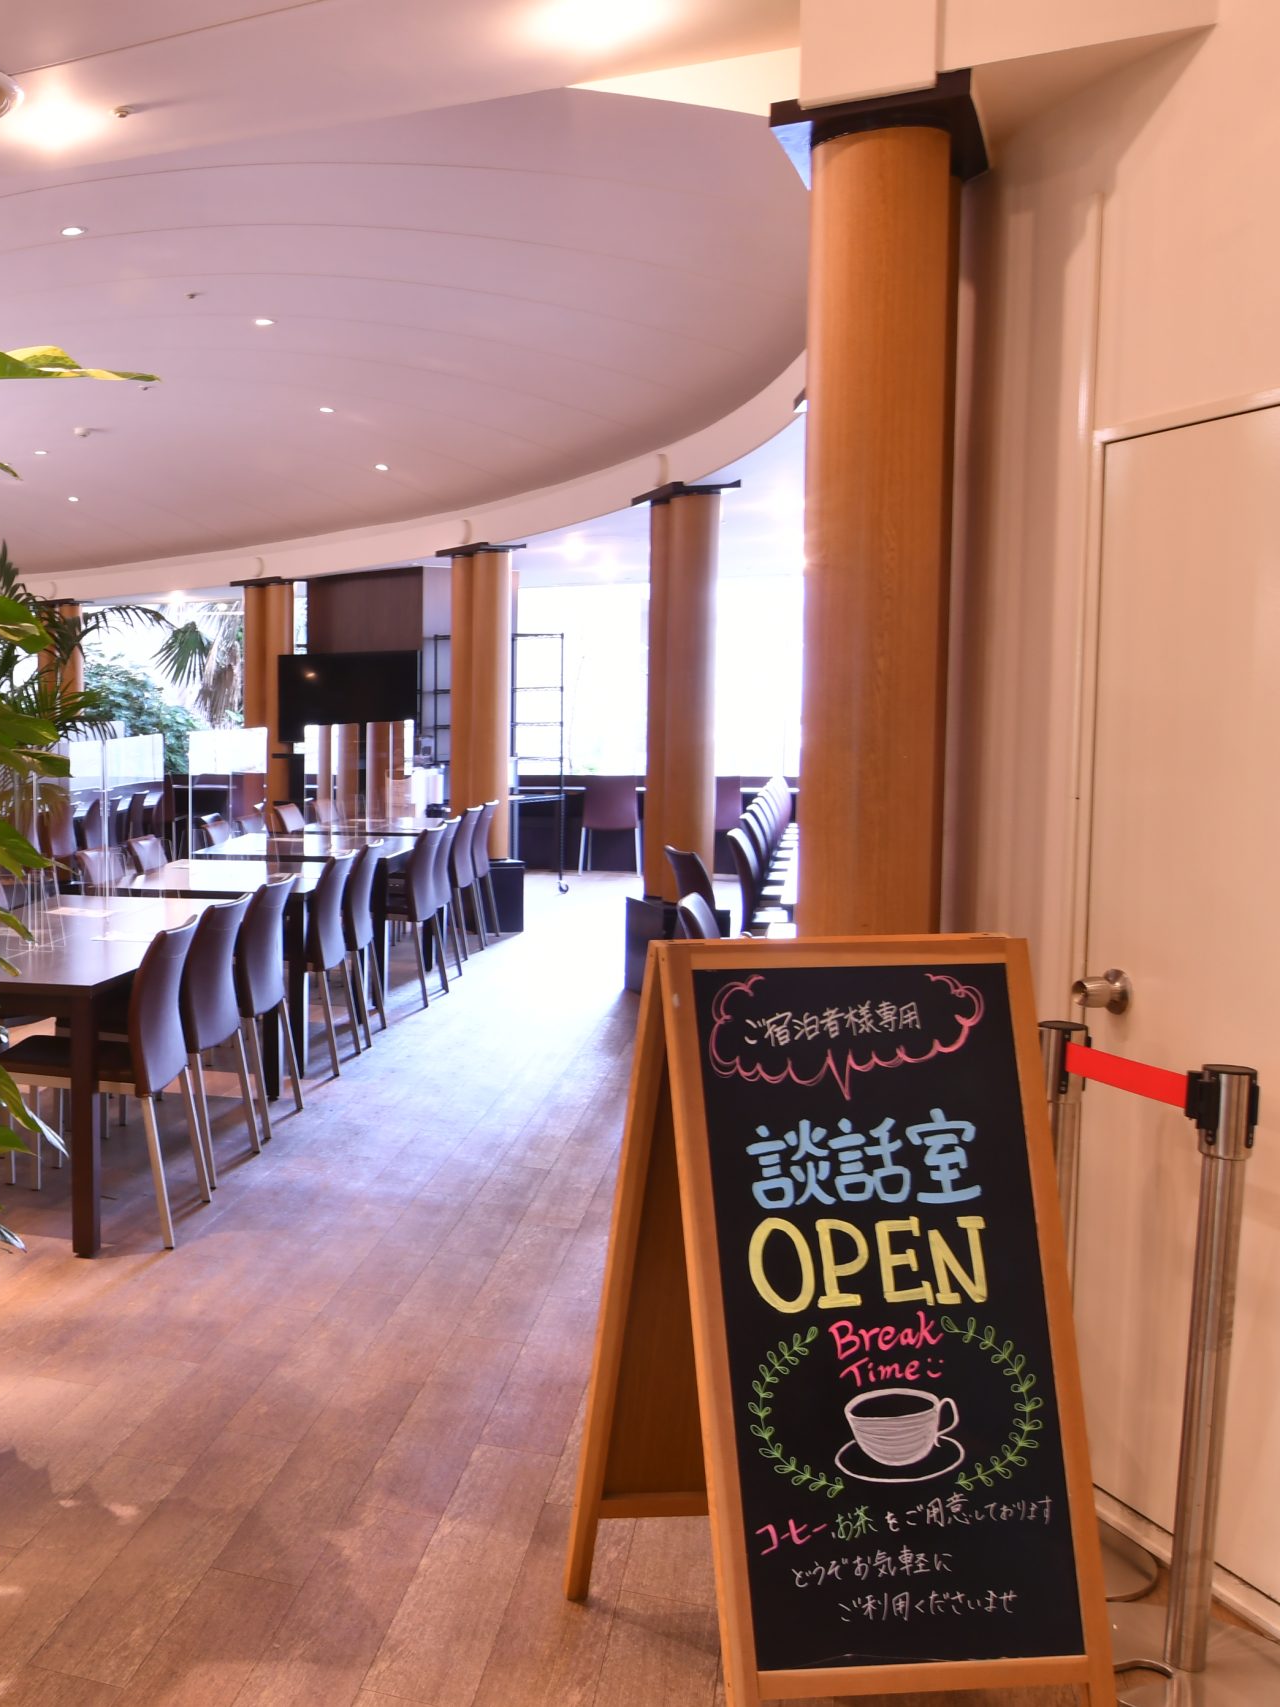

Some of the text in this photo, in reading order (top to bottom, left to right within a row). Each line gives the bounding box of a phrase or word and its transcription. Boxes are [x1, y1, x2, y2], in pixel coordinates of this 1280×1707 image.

[743, 1000, 922, 1047] ご宿泊者様専用
[745, 1107, 983, 1210] 談話室
[748, 1215, 989, 1314] OPEN
[827, 1310, 945, 1360] Break
[839, 1356, 922, 1388] Time
[791, 1544, 953, 1588] どうぞお気軽に
[838, 1588, 1019, 1623] ご利用くださいませ
